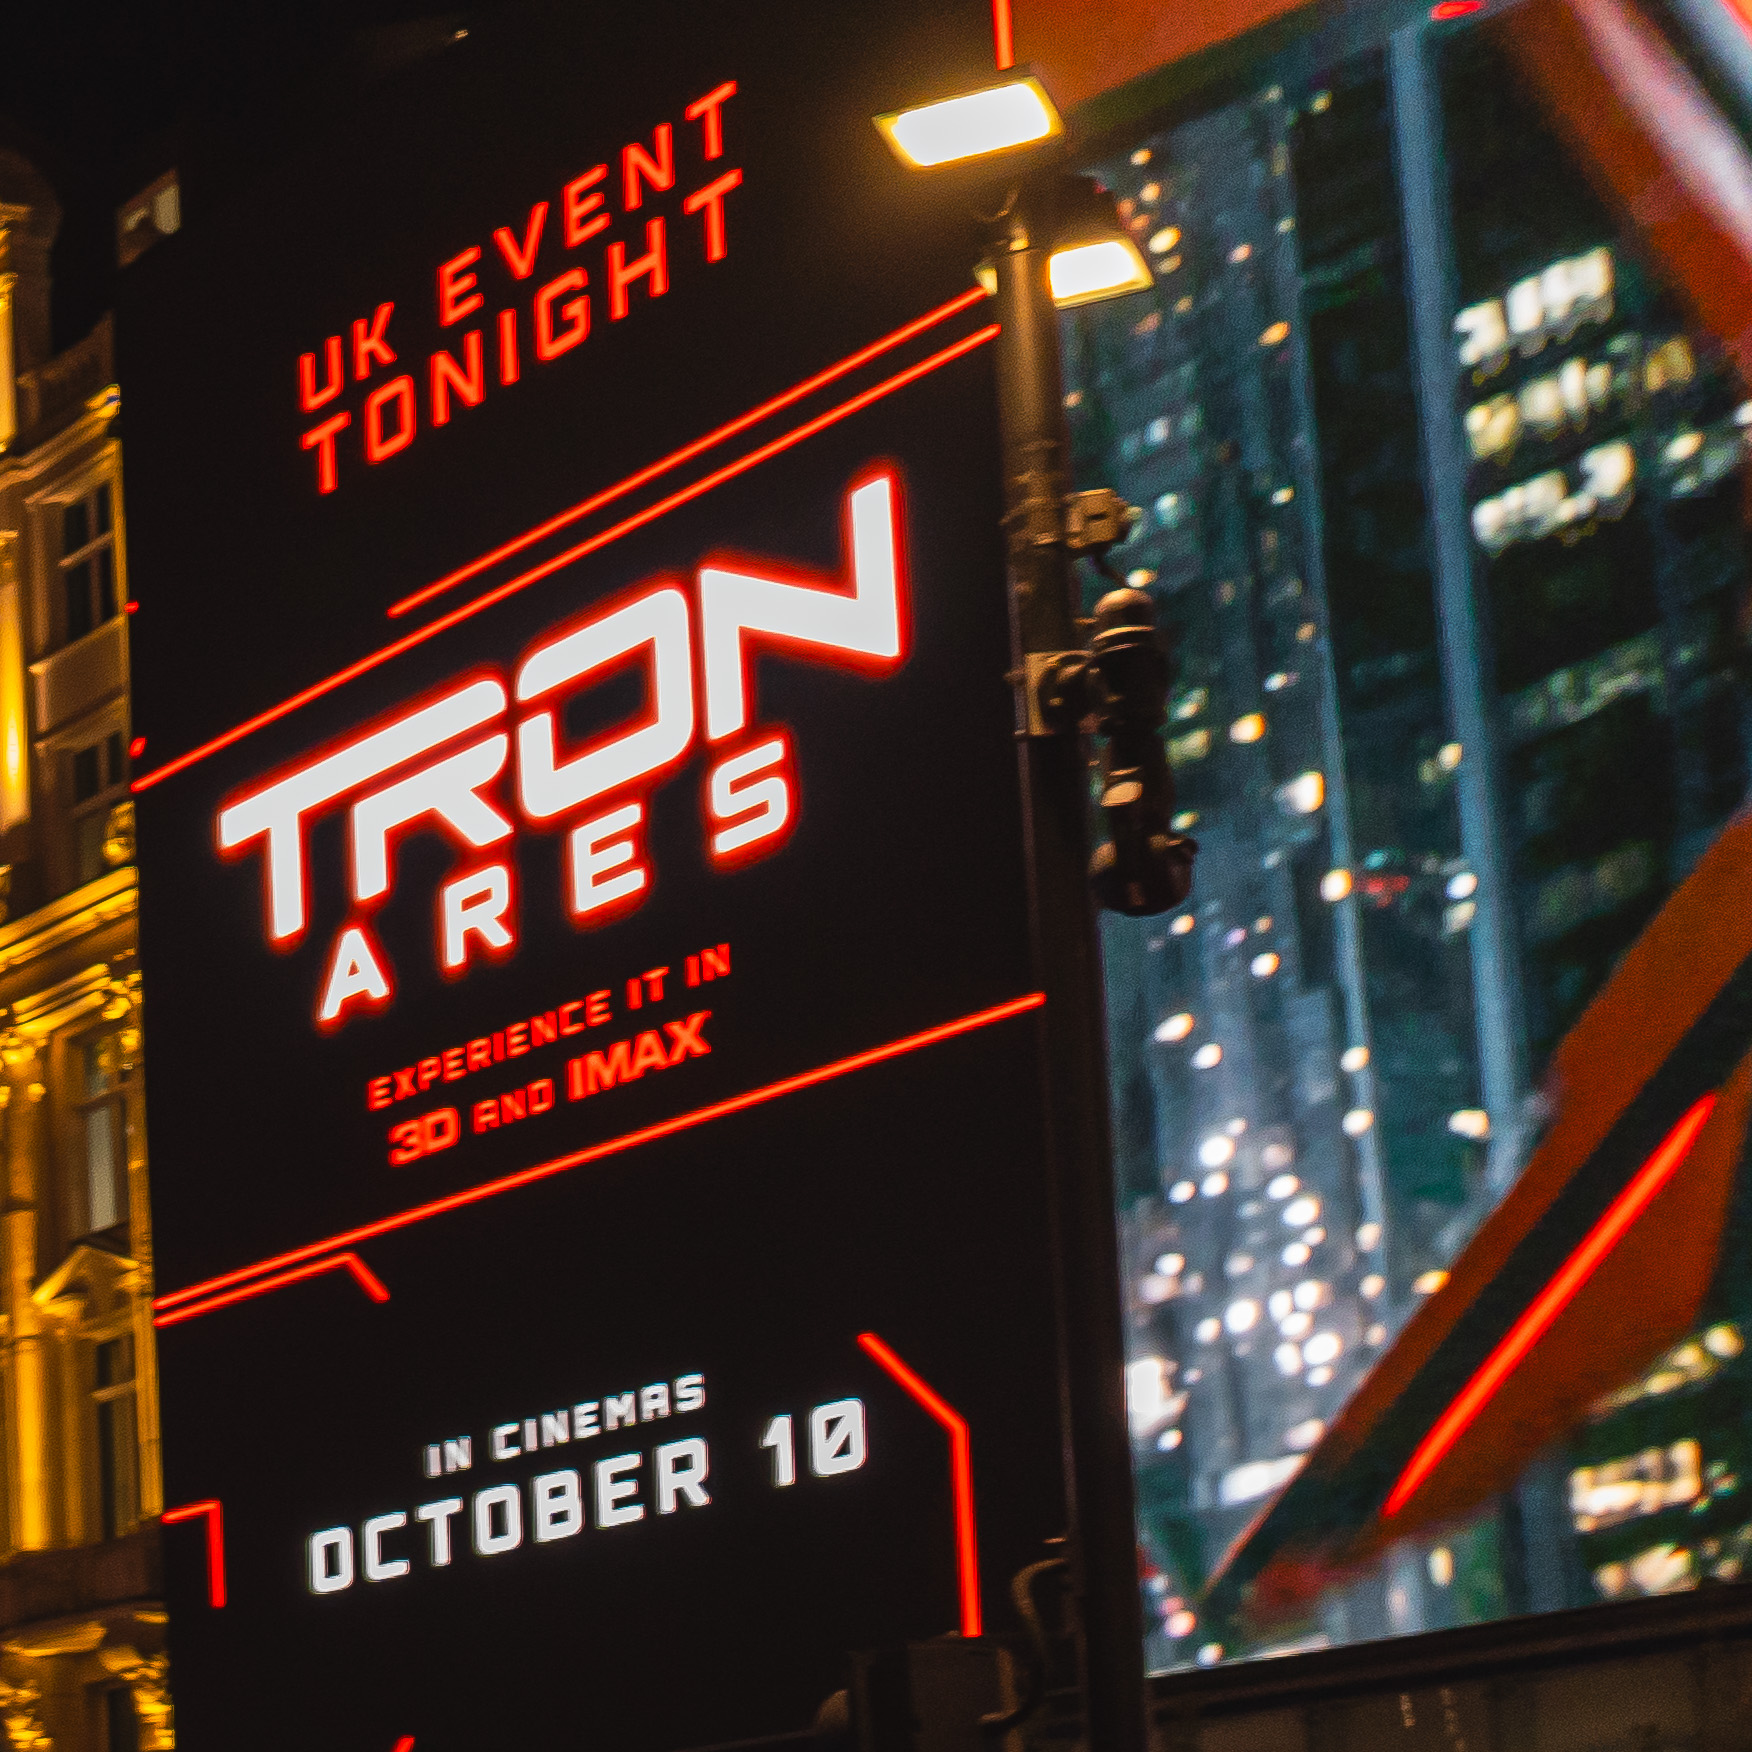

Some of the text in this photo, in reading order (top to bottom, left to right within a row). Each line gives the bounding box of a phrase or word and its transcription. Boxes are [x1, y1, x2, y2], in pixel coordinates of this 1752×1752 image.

[297, 80, 738, 414] UK EVENT
[299, 167, 744, 495] TONIGHT
[216, 470, 906, 942] TRON
[316, 733, 793, 1026] ARES
[367, 943, 731, 1111] EXPERIENCE IT IN
[388, 1010, 713, 1167] 3D AND IMAX
[306, 1395, 869, 1595] OCTOBER 10
[423, 1372, 707, 1478] IN CINEMAS
